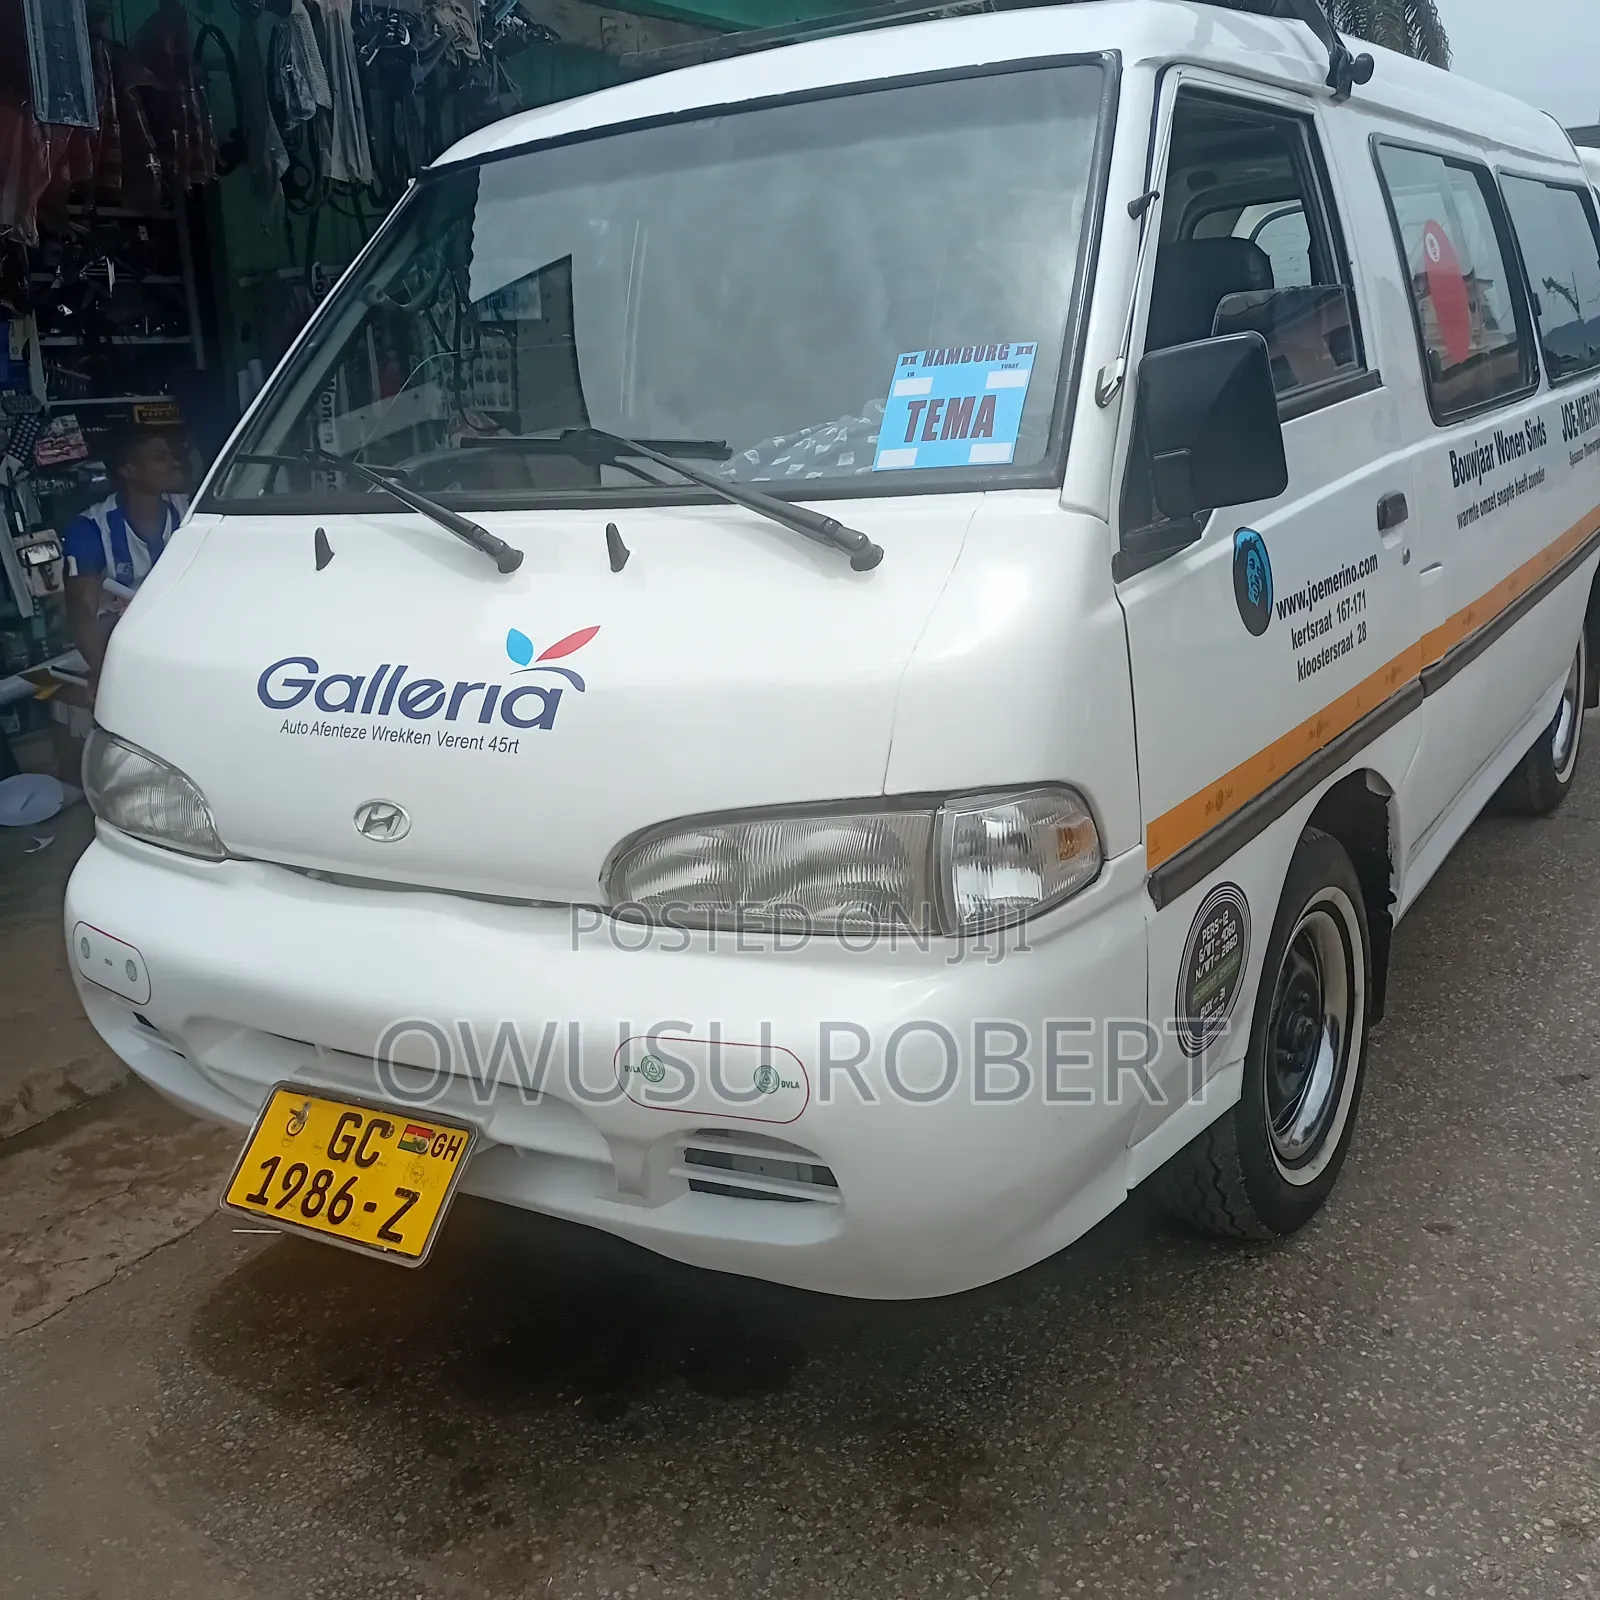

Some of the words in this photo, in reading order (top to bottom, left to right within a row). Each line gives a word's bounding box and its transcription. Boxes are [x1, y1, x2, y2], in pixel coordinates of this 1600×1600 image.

[922, 343, 1011, 368] HAMBURG
[903, 394, 997, 444] TEMA
[1448, 440, 1495, 489] Bouwjaar
[1493, 429, 1527, 466] Wonen
[1524, 415, 1547, 452] Sinds
[1276, 553, 1379, 621] www.joemerino.com
[1291, 609, 1333, 651] kertsraat
[1336, 588, 1367, 624] 167-171
[1297, 629, 1354, 682] kloostersraat
[1357, 620, 1367, 645] 28
[257, 656, 565, 731] Galleria
[280, 718, 309, 735] Auto
[310, 720, 367, 740] Afenteze
[371, 724, 431, 747] Wrekken
[437, 729, 484, 751] Verent
[488, 735, 520, 754] 45rt
[624, 1064, 642, 1074] DVLA
[781, 1080, 800, 1089] DVLA
[327, 1111, 394, 1169] GC
[430, 1132, 463, 1163] GH
[245, 1155, 421, 1244] 1986-Z
